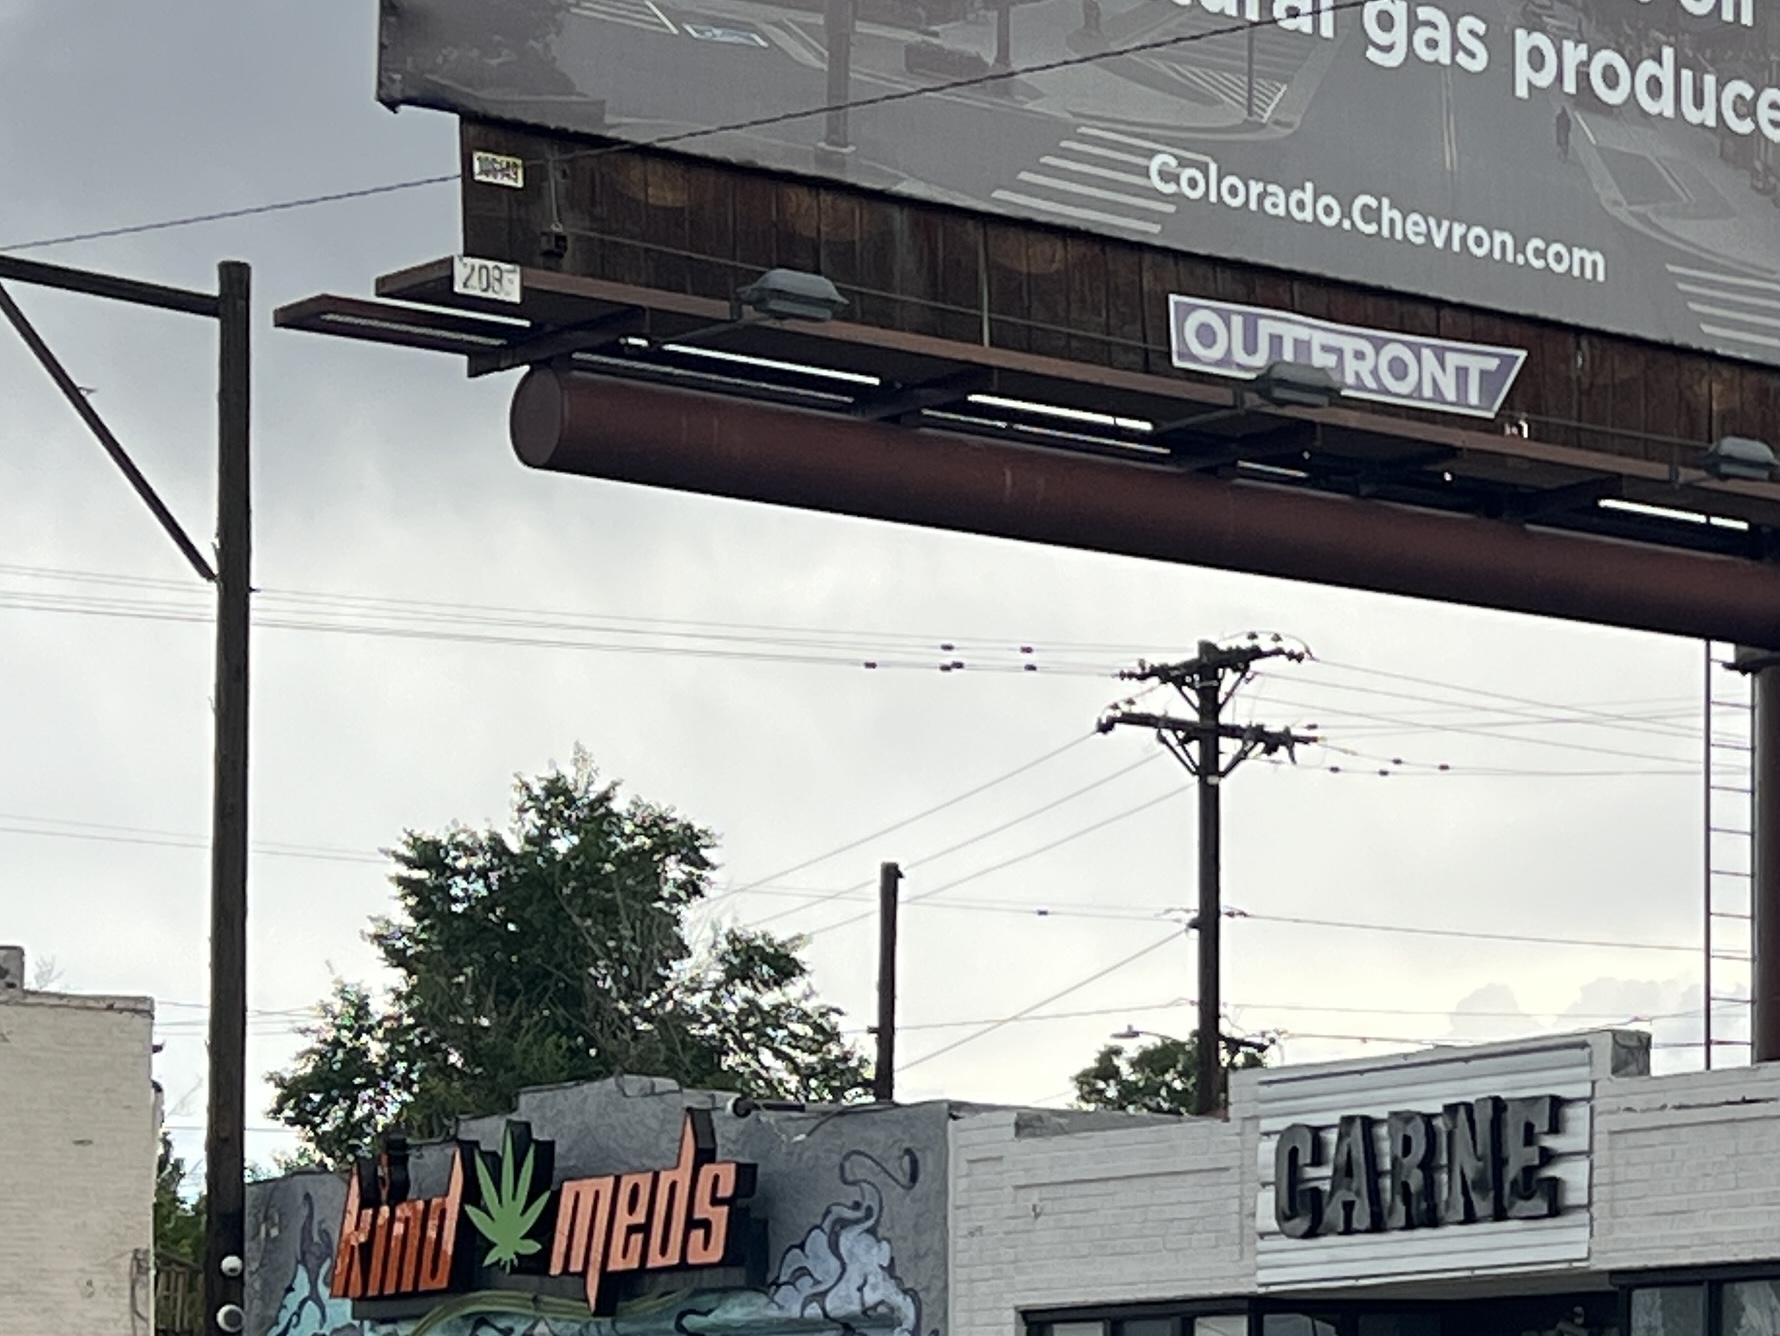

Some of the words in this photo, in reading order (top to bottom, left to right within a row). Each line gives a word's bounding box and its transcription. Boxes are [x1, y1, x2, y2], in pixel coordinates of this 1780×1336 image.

[1363, 0, 1489, 73] gas
[1148, 153, 1606, 283] Colorado.Chevron.com
[1182, 308, 1501, 405] OUTFRONT
[549, 1108, 738, 1316] meds
[1275, 1096, 1559, 1239] CARNE
